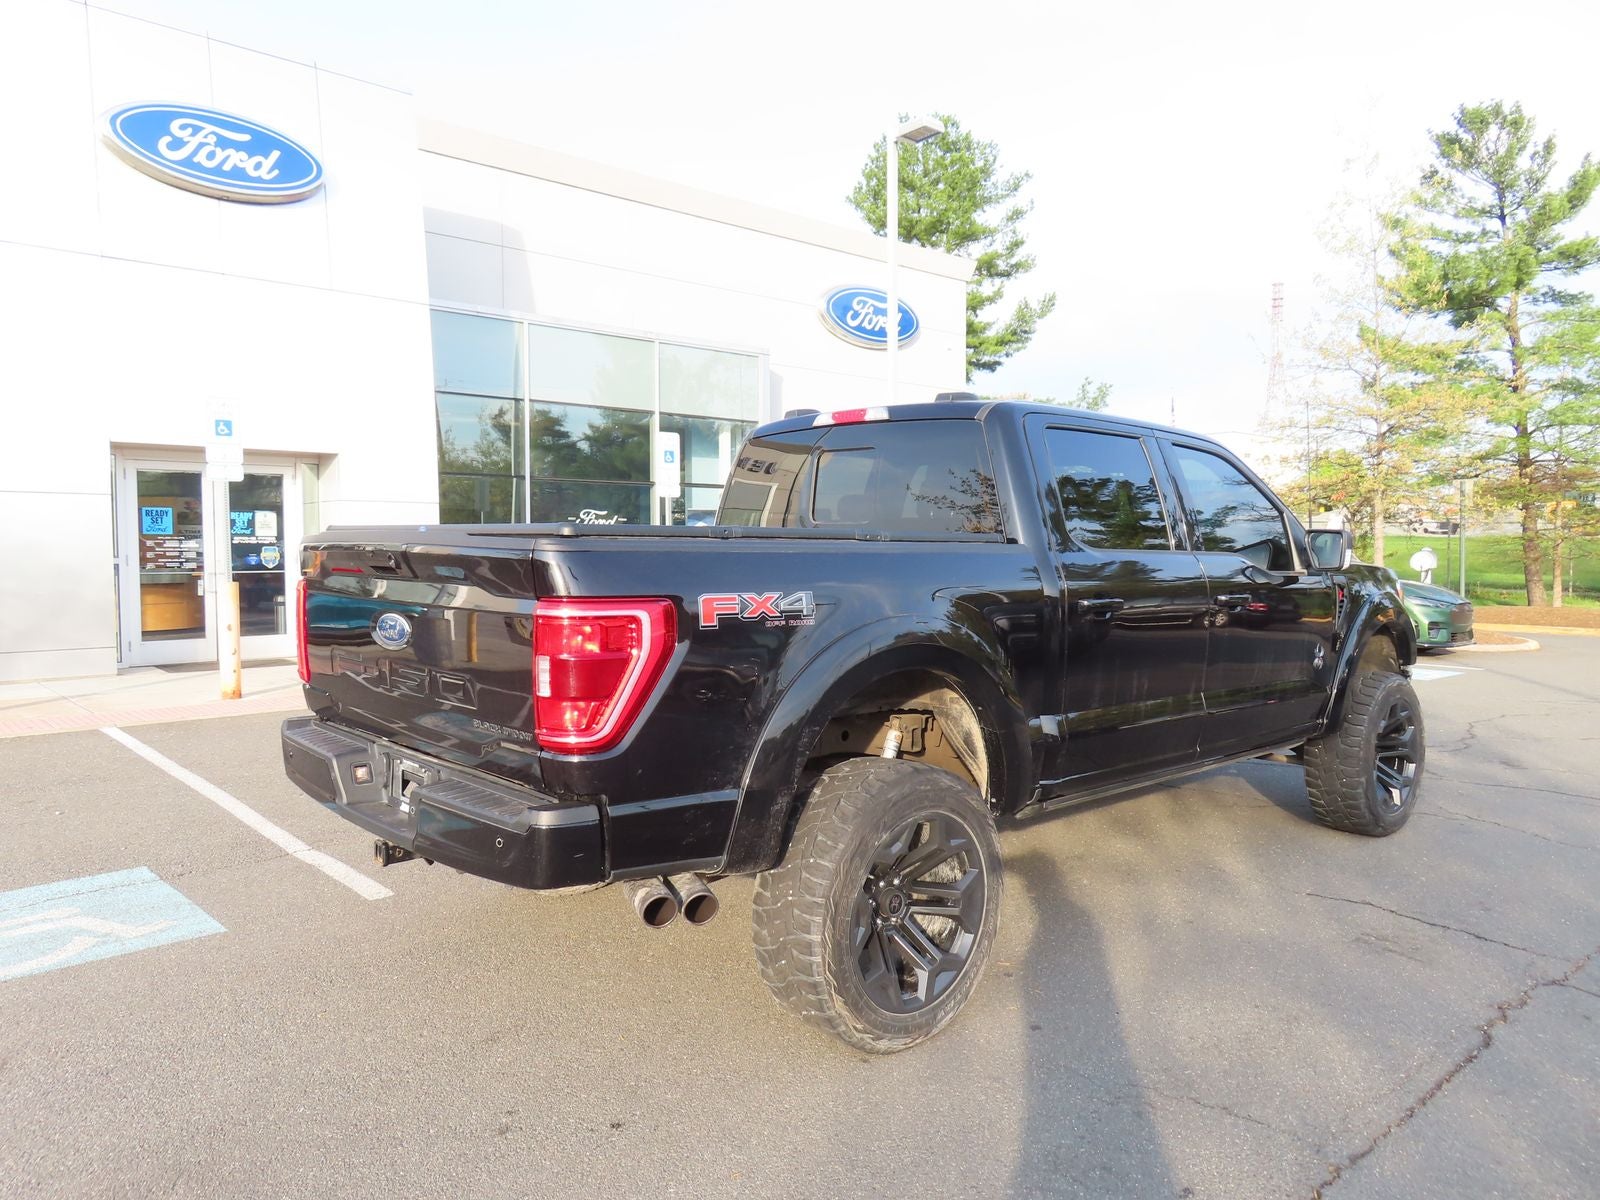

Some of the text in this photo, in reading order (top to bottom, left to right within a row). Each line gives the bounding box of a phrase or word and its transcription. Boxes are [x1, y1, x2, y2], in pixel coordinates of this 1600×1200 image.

[157, 117, 281, 180] Ford
[846, 296, 903, 333] For
[145, 509, 169, 517] READY
[230, 511, 253, 520] READY
[150, 516, 164, 525] SET
[235, 519, 249, 528] SET
[146, 524, 168, 533] Ford
[231, 527, 254, 535] Ford
[698, 591, 816, 630] FX4
